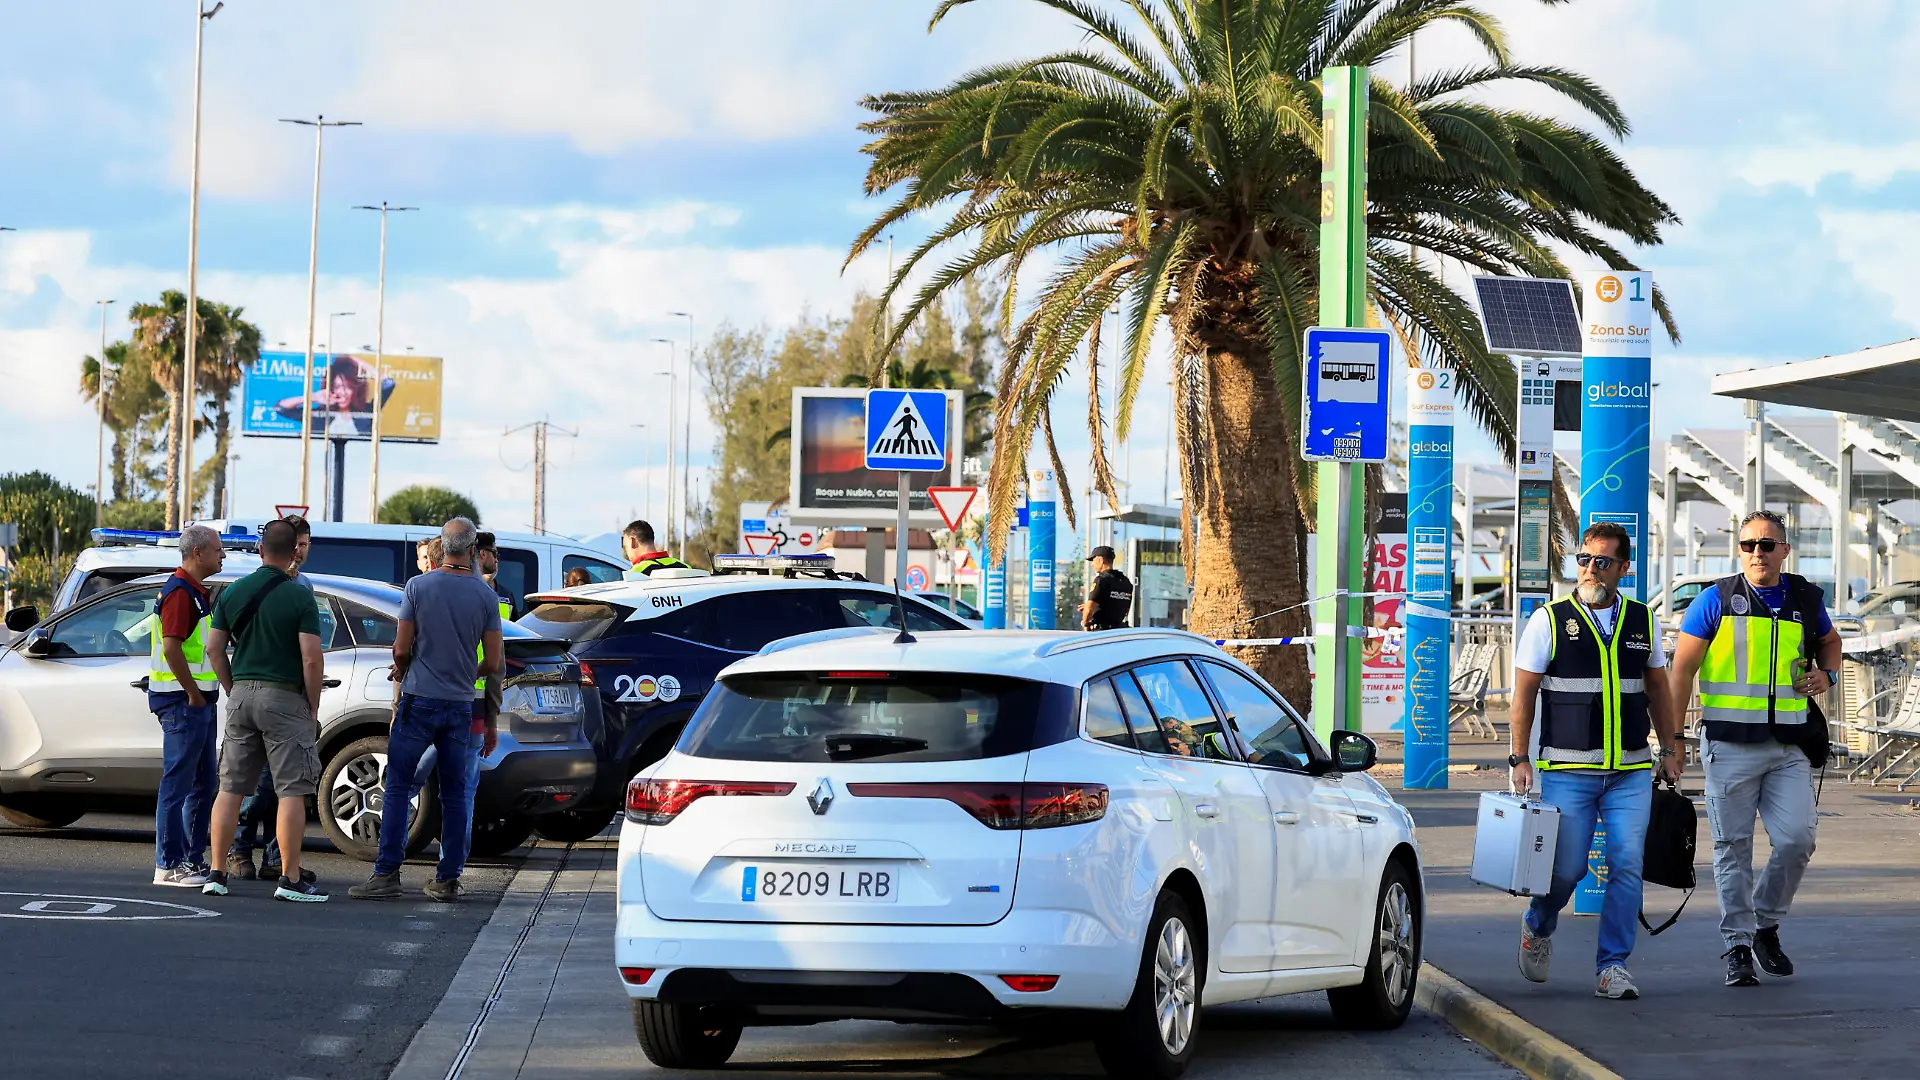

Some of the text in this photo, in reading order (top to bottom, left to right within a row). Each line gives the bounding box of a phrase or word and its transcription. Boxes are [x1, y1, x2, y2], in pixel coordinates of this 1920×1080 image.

[1629, 276, 1645, 301] 1
[1589, 324, 1650, 336] Zona Sur
[269, 359, 327, 377] Miraor
[1439, 372, 1450, 389] 2
[1587, 380, 1649, 402] global
[1425, 403, 1454, 412] Express
[1334, 438, 1360, 448] 099001
[1411, 440, 1452, 455] global
[1334, 448, 1360, 458] 099003
[1046, 471, 1053, 481] 3
[815, 488, 844, 498] Roque
[846, 488, 875, 499] Nublo,
[876, 488, 898, 498] Gran
[651, 595, 683, 608] 6NH
[774, 843, 857, 854] MEGANE
[761, 871, 830, 897] 8209
[839, 871, 891, 898] LRB
